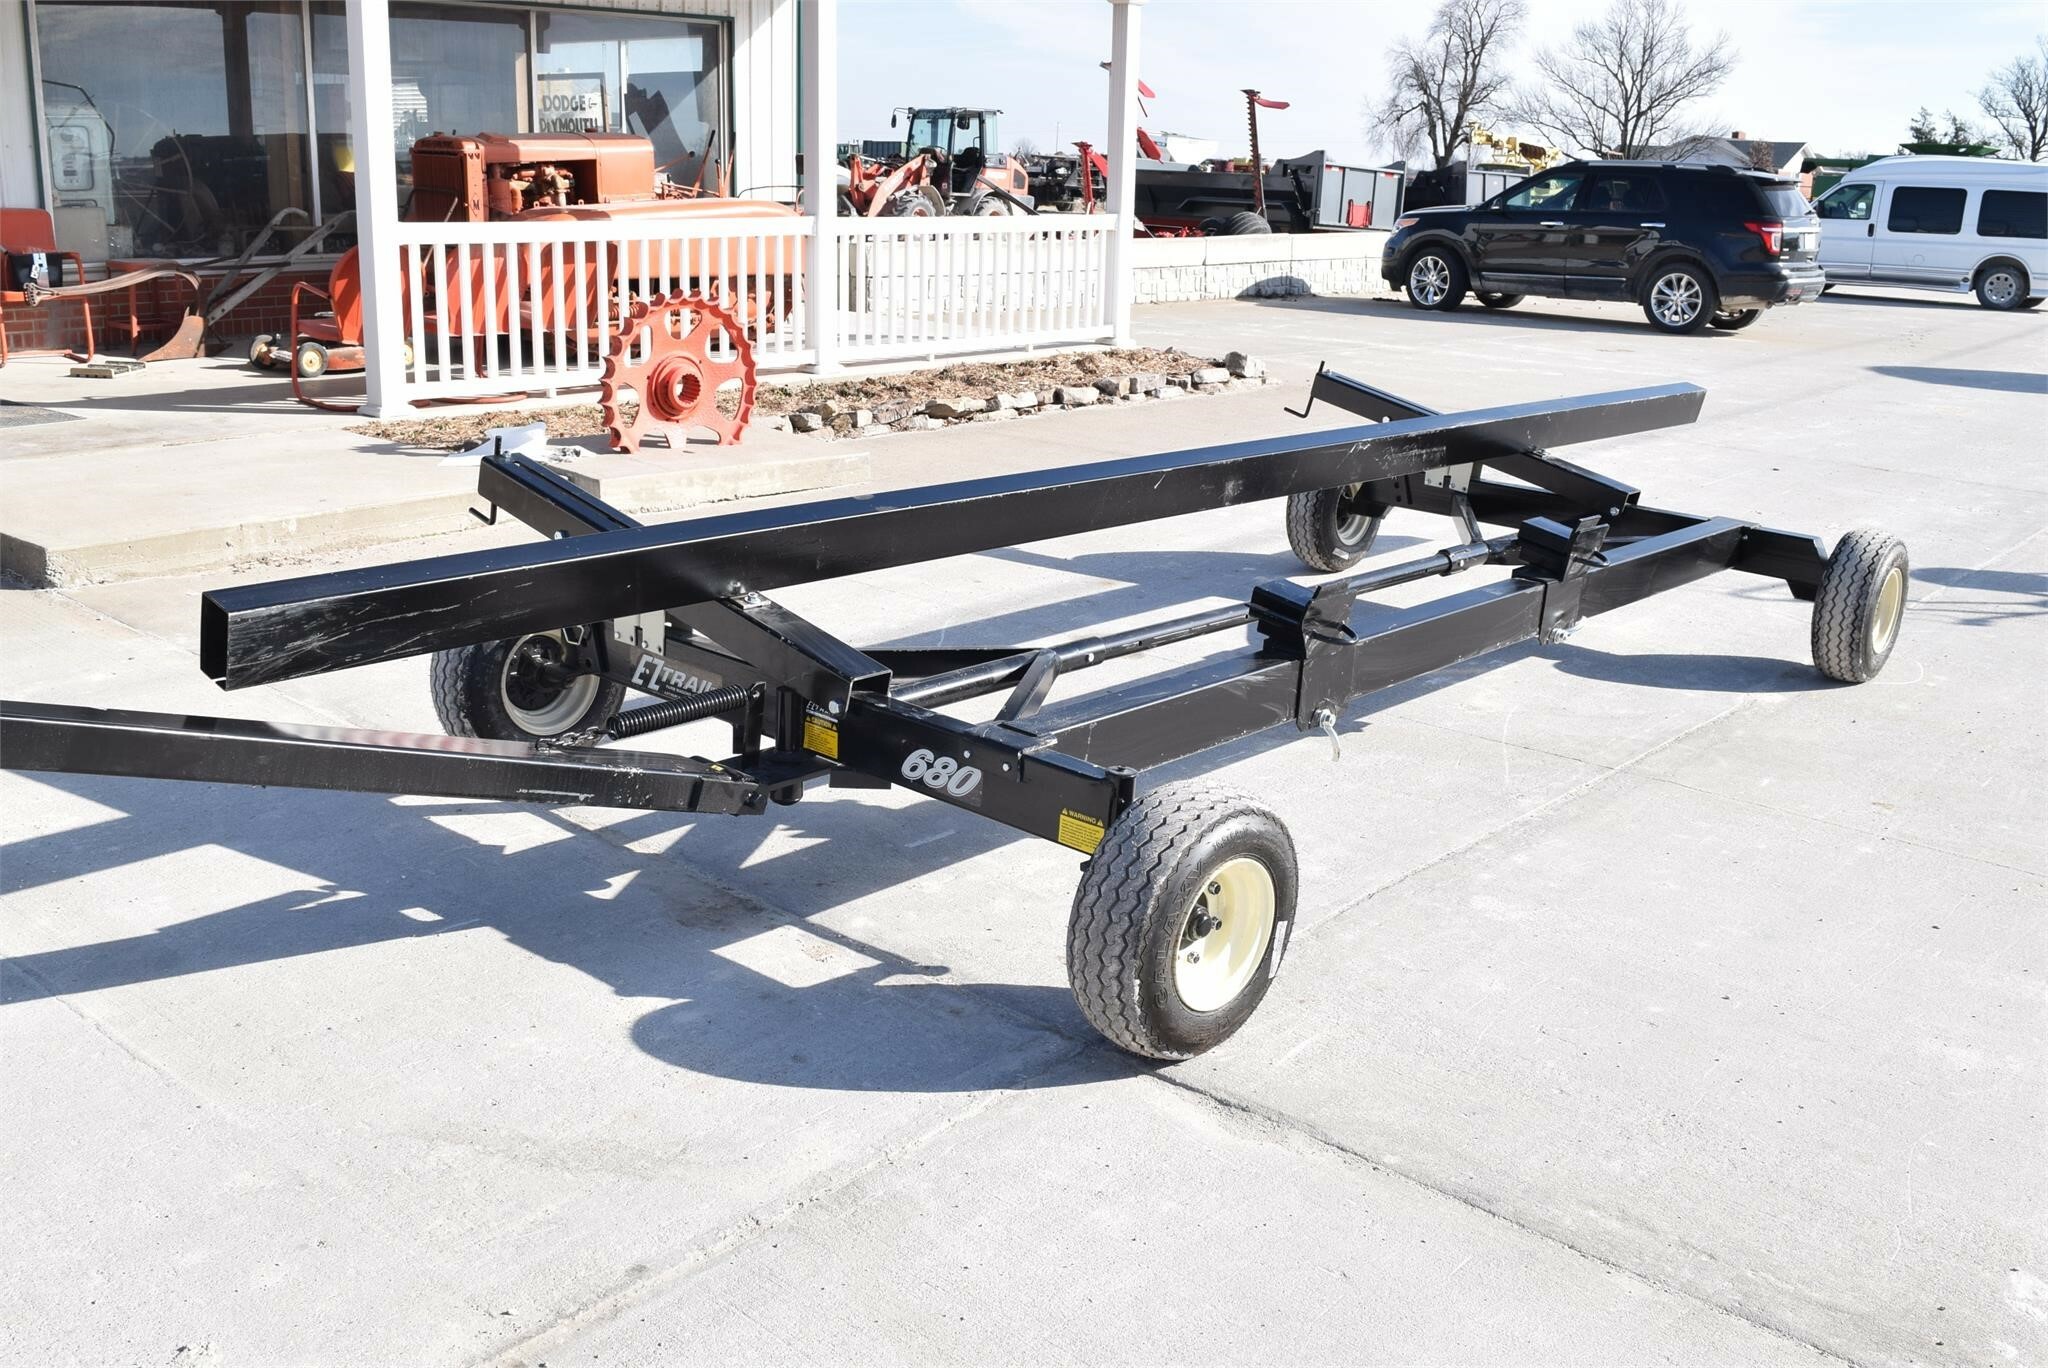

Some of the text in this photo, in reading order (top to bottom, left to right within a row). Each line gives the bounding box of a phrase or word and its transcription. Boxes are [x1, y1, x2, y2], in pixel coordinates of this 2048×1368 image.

[543, 94, 586, 112] DODGE
[901, 748, 982, 797] 680
[1068, 809, 1097, 824] WARNING
